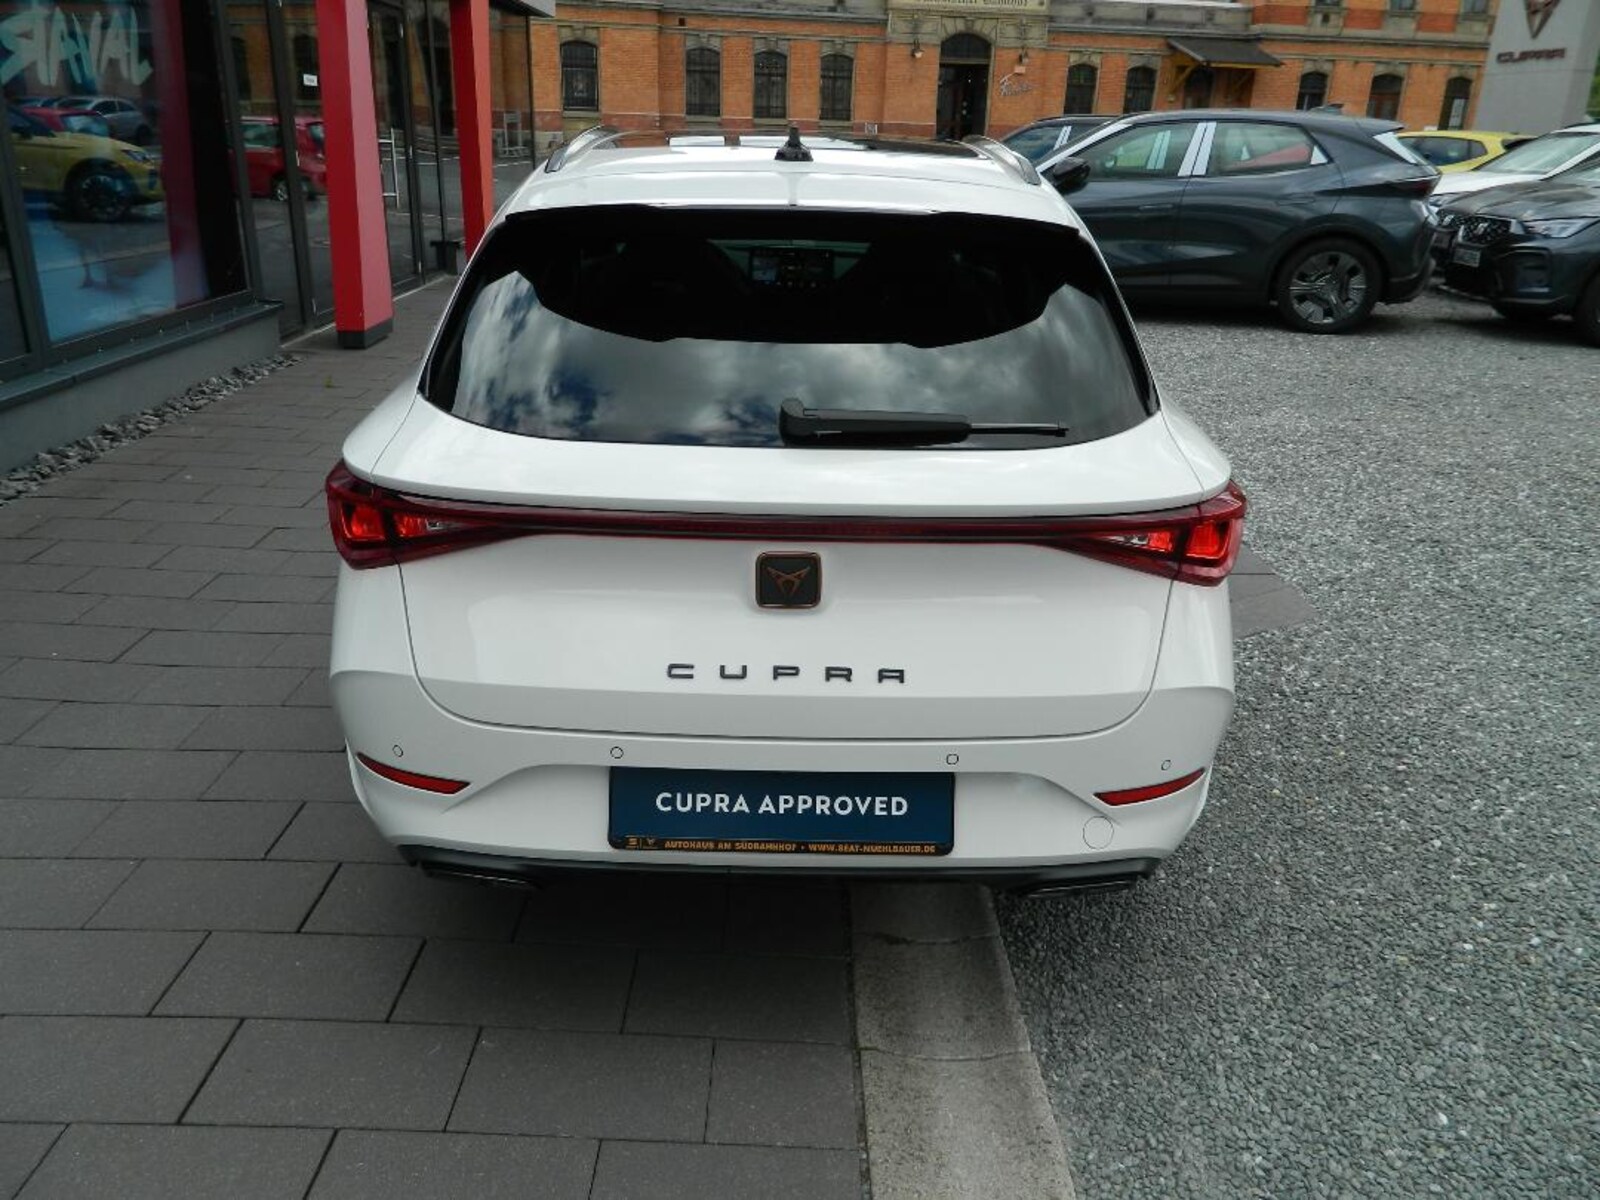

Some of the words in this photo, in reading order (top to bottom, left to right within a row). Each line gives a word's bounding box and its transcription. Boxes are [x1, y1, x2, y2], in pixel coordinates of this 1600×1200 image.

[667, 663, 905, 684] CUPRA
[655, 792, 750, 814] CUPRA
[758, 795, 909, 816] APPROVED
[664, 840, 715, 850] AUTOHAUS
